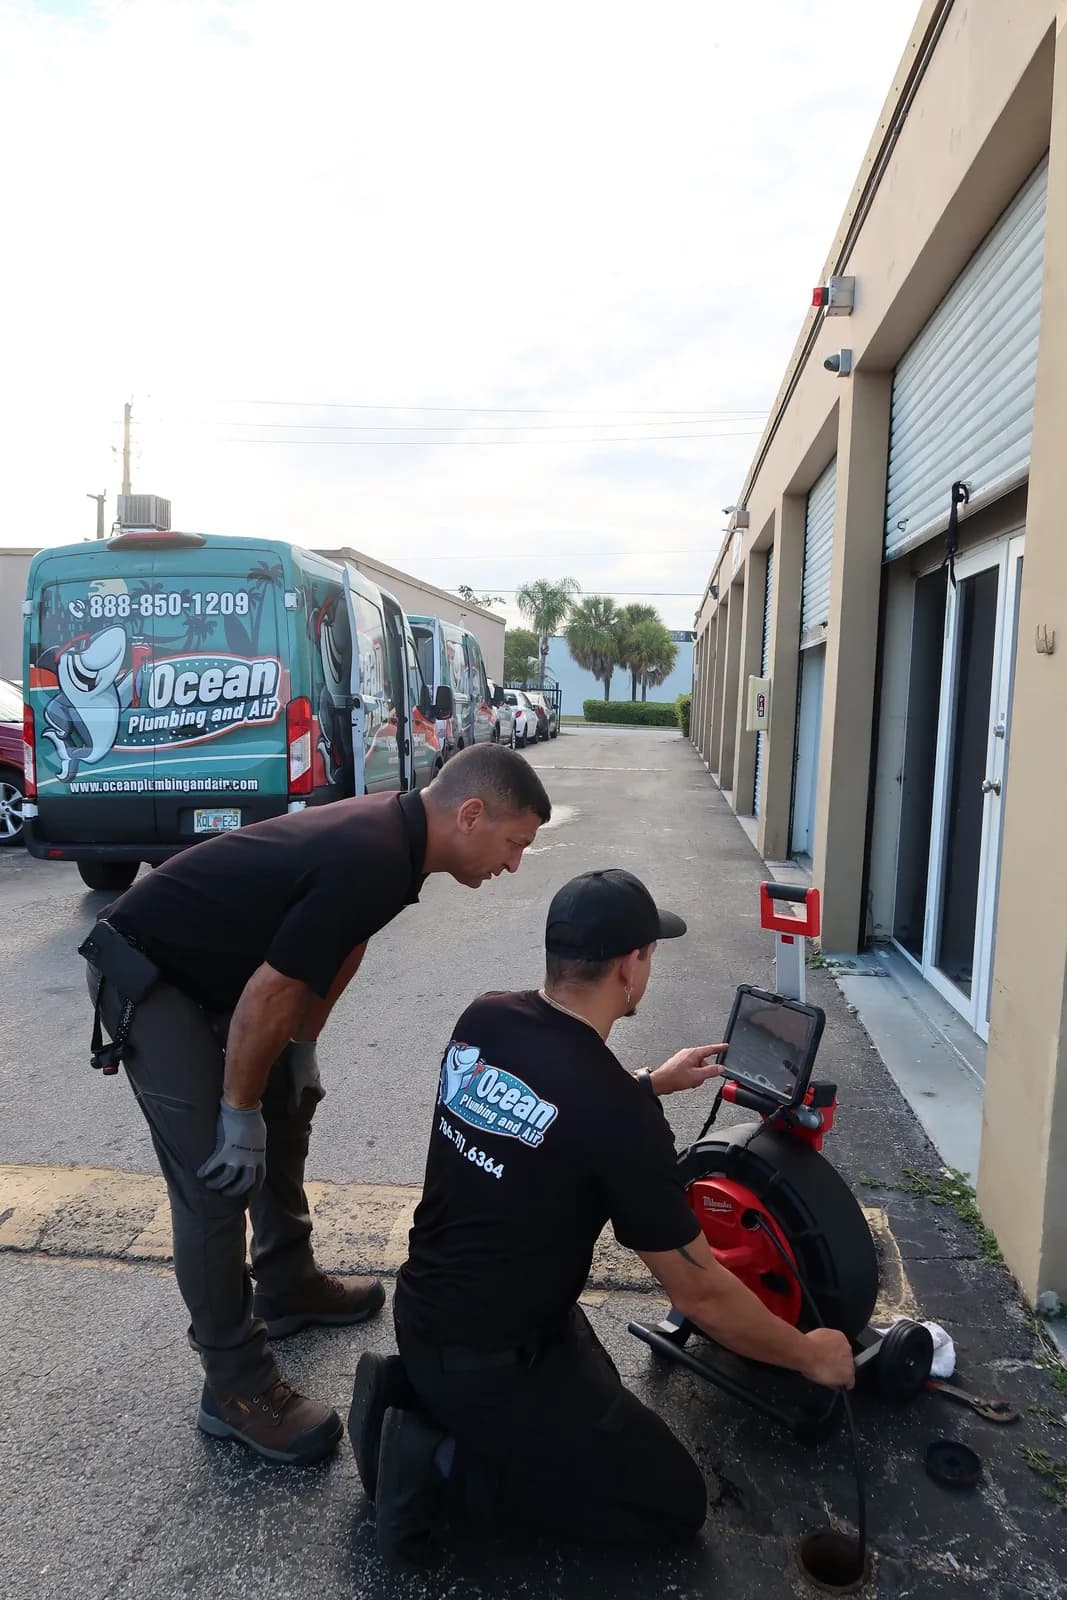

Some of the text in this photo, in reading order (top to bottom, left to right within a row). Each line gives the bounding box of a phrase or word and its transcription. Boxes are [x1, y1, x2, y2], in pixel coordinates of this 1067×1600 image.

[89, 592, 249, 618] 888-850-1209
[148, 661, 278, 709] Ocean
[128, 700, 276, 734] Plumbing and Air
[70, 778, 258, 793] www.oceanplumbingandair.com
[459, 1093, 541, 1144] Plumbing and Air
[476, 1069, 555, 1129] Ocean
